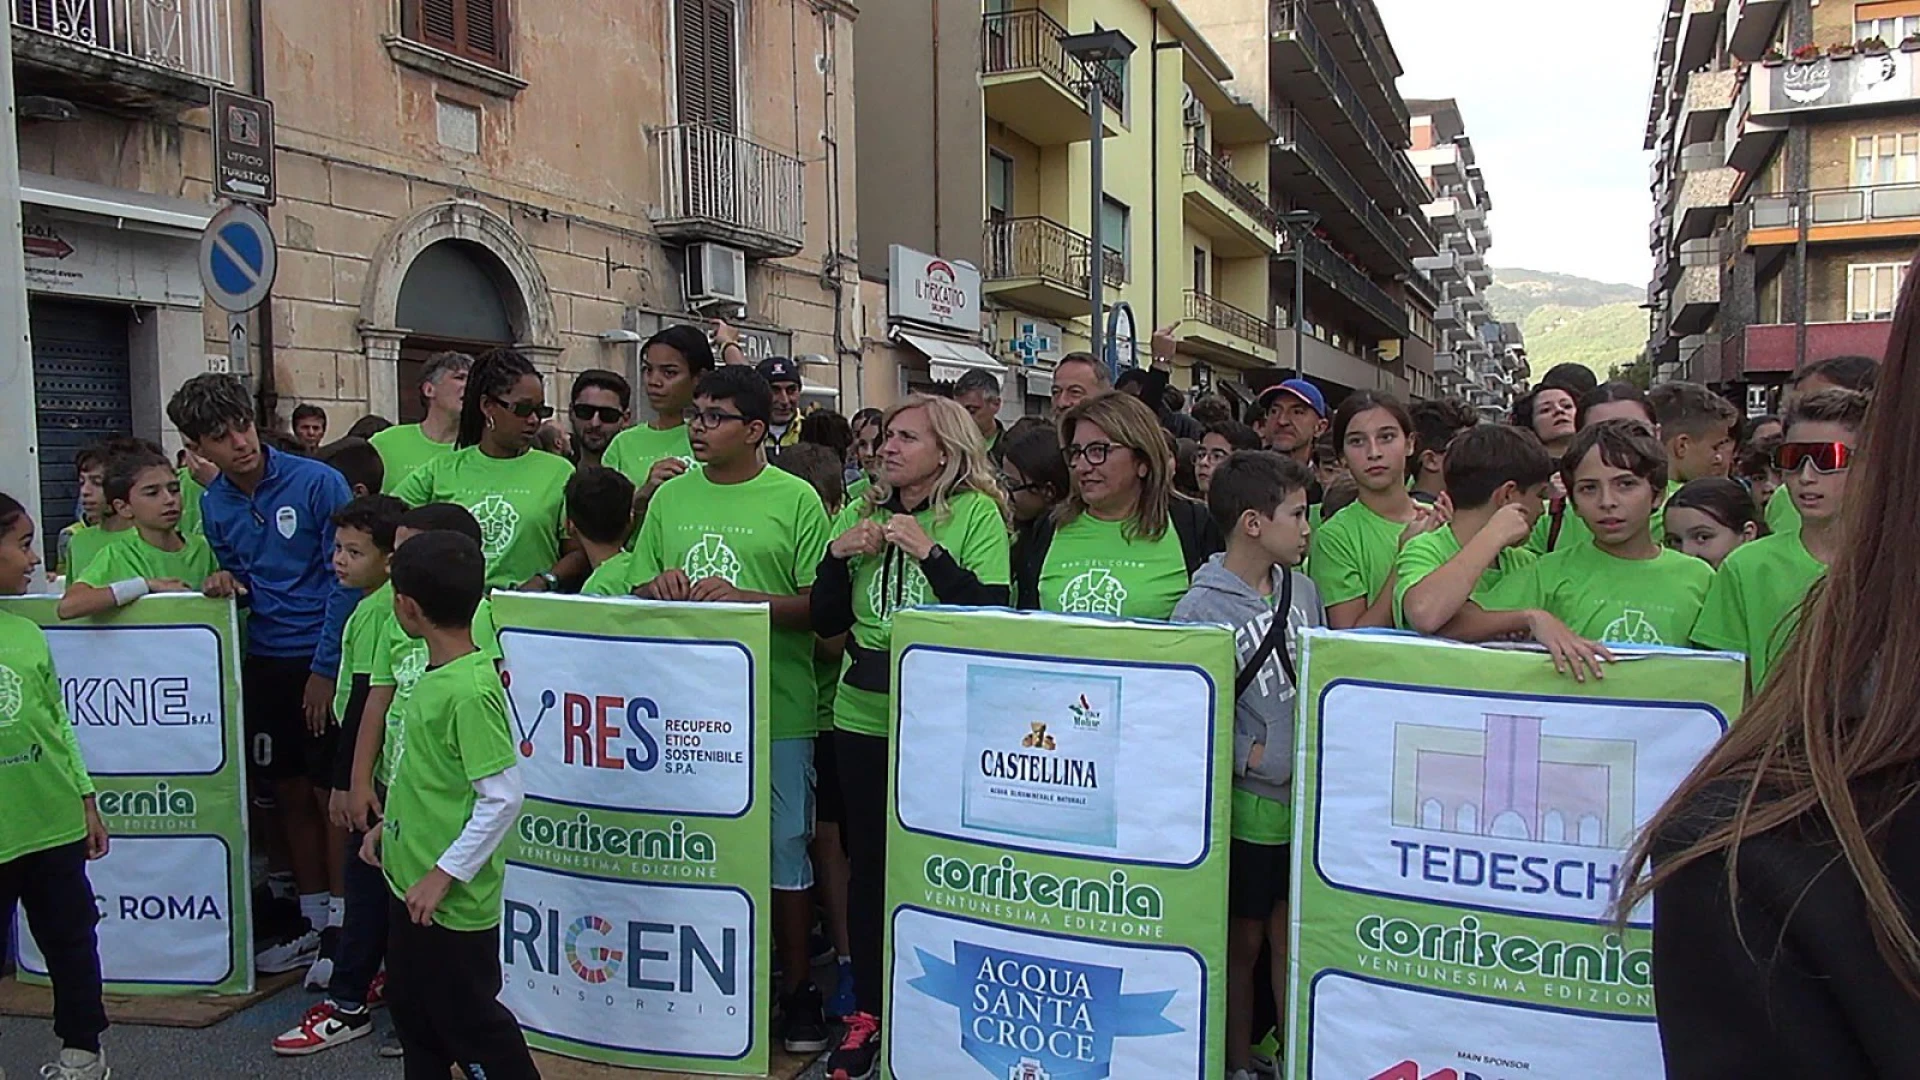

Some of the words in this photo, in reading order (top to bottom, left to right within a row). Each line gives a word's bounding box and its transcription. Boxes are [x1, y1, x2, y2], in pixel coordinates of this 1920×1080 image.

[221, 166, 270, 184] TURISTICO
[915, 279, 922, 298] IL
[60, 677, 190, 726] KNE
[563, 692, 660, 772] RES
[665, 719, 732, 734] RECUPERO
[665, 735, 701, 747] ETICO
[665, 748, 743, 763] SOSTENIBILE
[665, 763, 696, 775] S.P.A.
[981, 749, 1098, 788] CASTELLINA
[97, 780, 197, 817] ernia
[518, 811, 717, 863] corrisernia
[518, 845, 621, 872] VENTUNESIMA
[631, 861, 718, 878] EDIZIONE
[1390, 839, 1619, 900] TEDESCH
[119, 894, 222, 920] ROMA
[924, 854, 1164, 921] corrisernia
[924, 889, 1051, 925] VENTUNESIMA
[1064, 914, 1165, 938] EDIZIONE
[1356, 915, 1653, 988] corrisernia
[503, 973, 737, 1016] CONSORZIO
[976, 955, 1093, 1001] ACQUA
[1357, 953, 1527, 993] VENTUNESIMA
[1544, 983, 1651, 1008] EDIZION
[972, 983, 1096, 1033] SANTA
[972, 1016, 1096, 1063] CROCE
[1457, 1051, 1482, 1063] MAIN
[1483, 1055, 1531, 1070] SPONSOR
